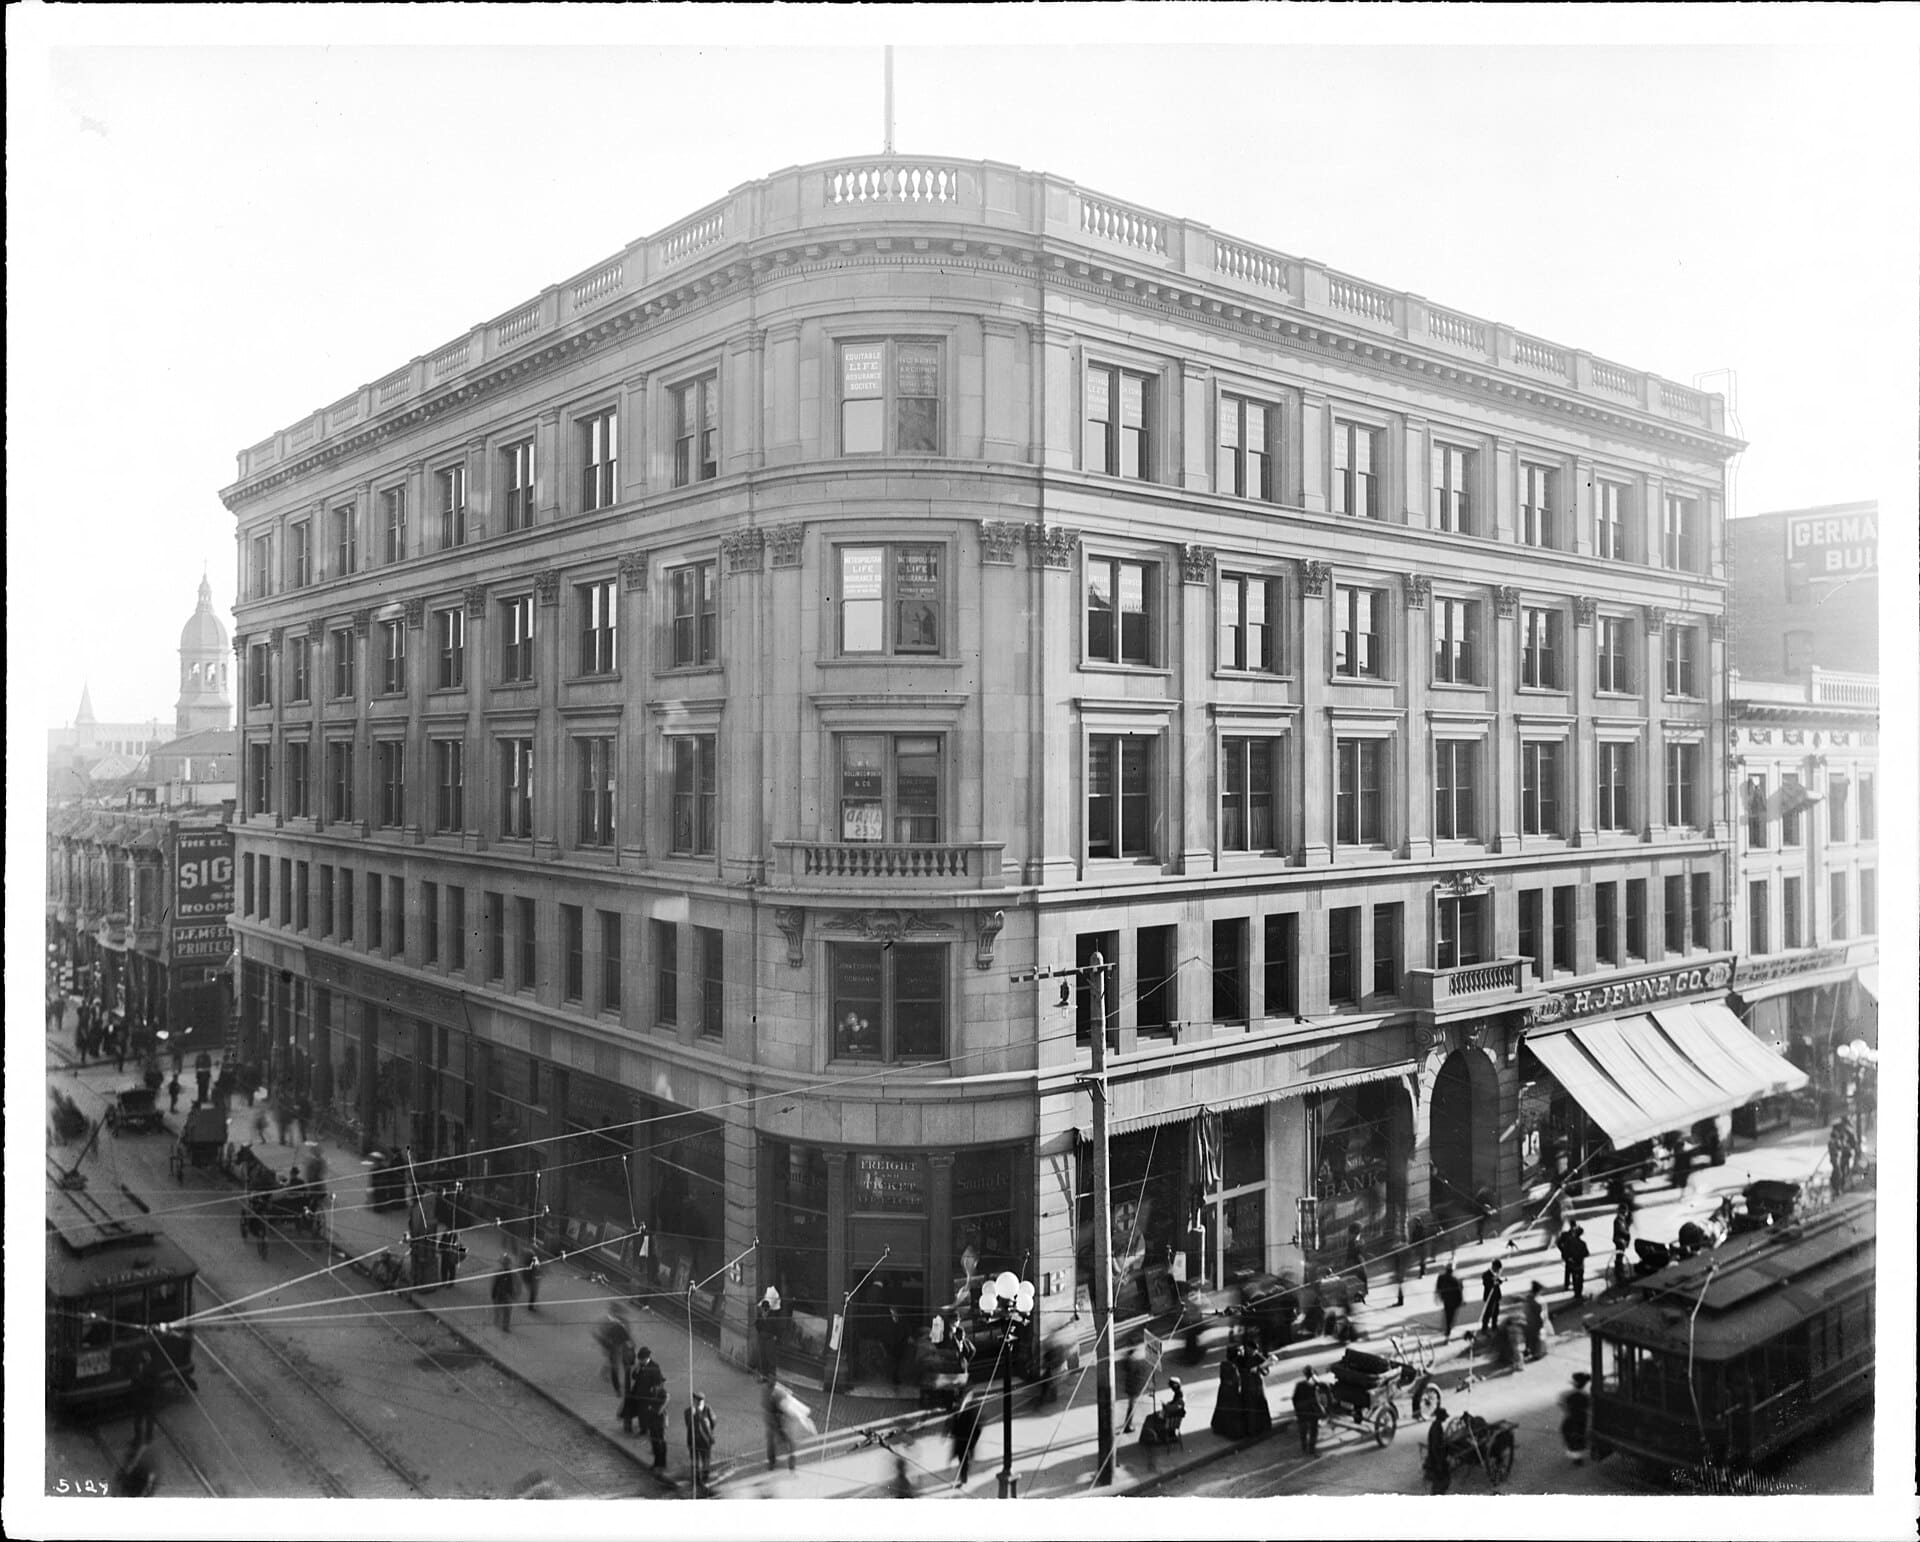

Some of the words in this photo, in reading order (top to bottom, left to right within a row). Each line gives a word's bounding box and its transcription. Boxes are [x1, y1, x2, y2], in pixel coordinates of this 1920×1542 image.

[849, 362, 878, 371] LIFE
[852, 565, 874, 574] LIFE
[906, 565, 928, 574] LIFE
[1596, 976, 1671, 1007] JEVNE
[861, 1160, 918, 1171] FREIGHT
[1325, 1172, 1379, 1199] BANK
